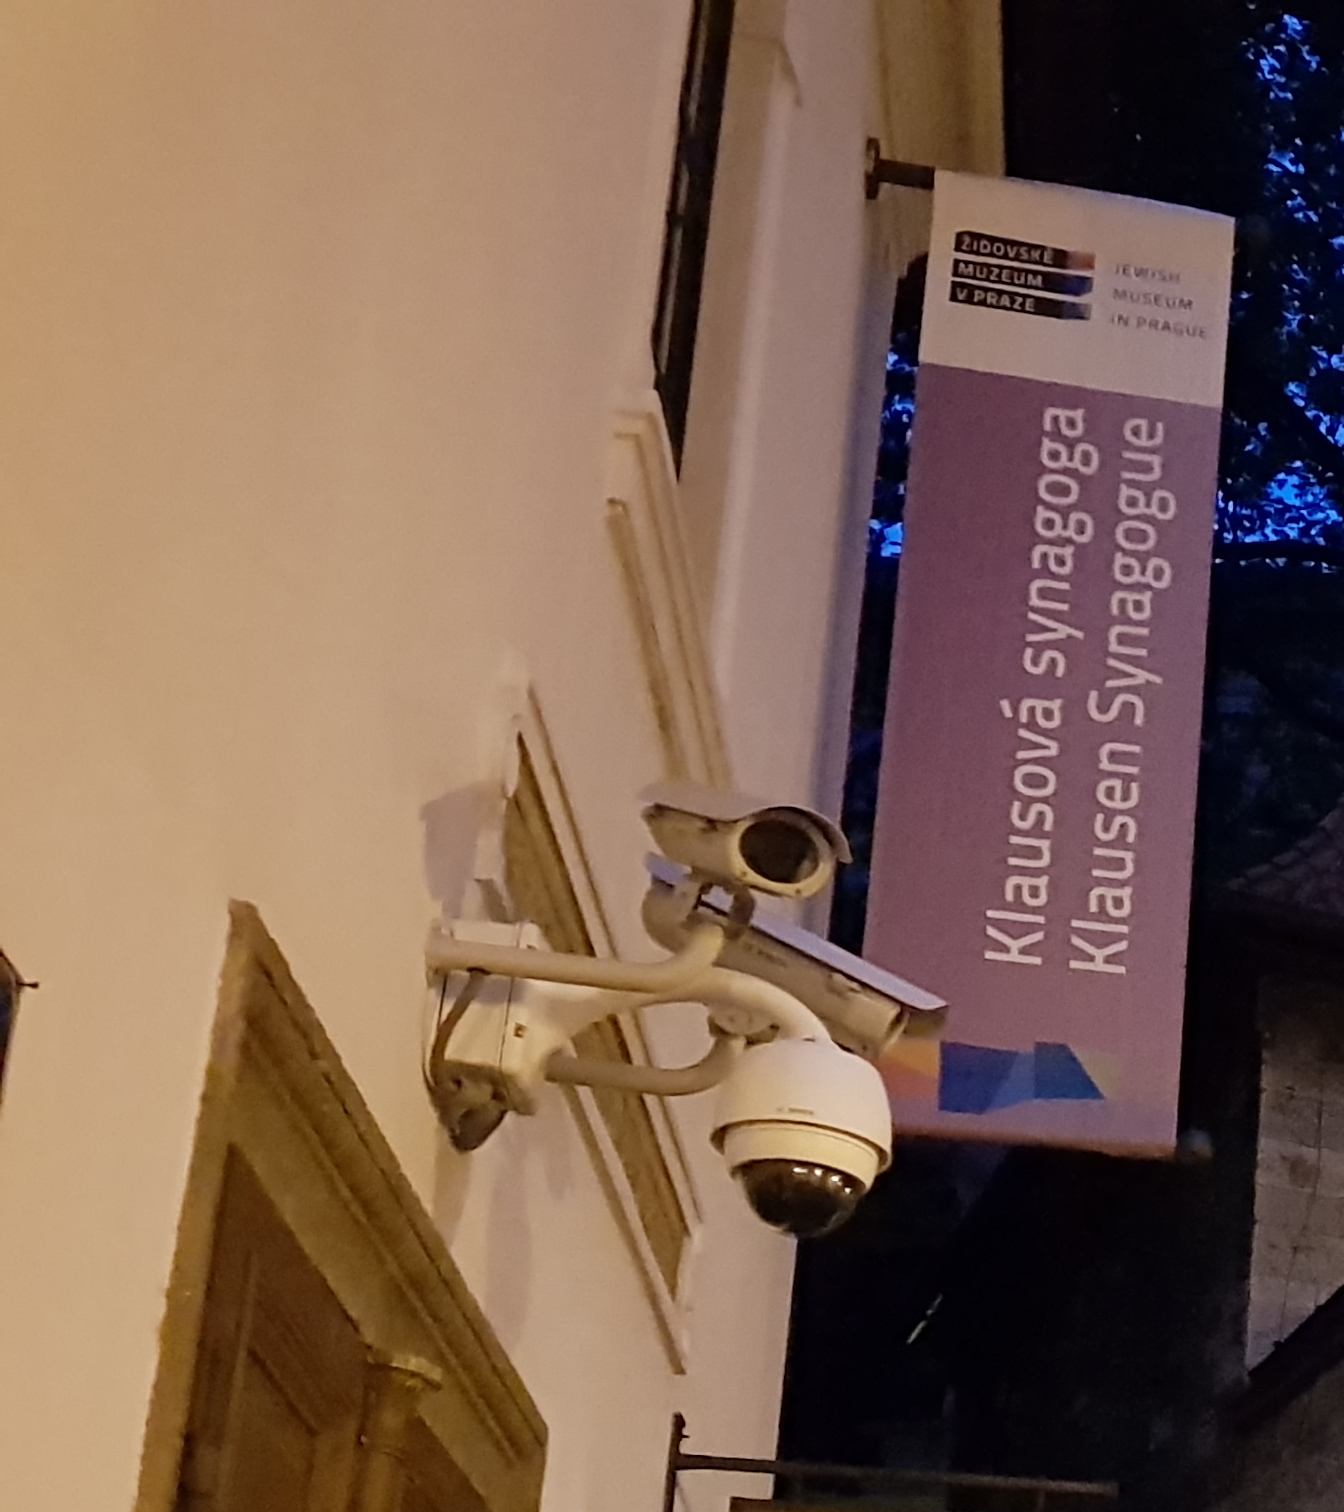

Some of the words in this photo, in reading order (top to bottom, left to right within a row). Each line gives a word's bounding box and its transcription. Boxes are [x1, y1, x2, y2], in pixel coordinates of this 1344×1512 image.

[956, 261, 1044, 288] MUZEUM
[1114, 263, 1182, 284] JEWISH
[955, 286, 969, 302] V
[973, 291, 1036, 312] PRAZE
[1111, 287, 1194, 311] MUSEUM
[1110, 313, 1129, 327] IN
[1136, 316, 1207, 340] PRAGUE
[1022, 406, 1100, 679] synagoga
[1086, 417, 1177, 728] Synagogue
[983, 697, 1063, 965] Klausová
[1068, 741, 1143, 975] Klausen
